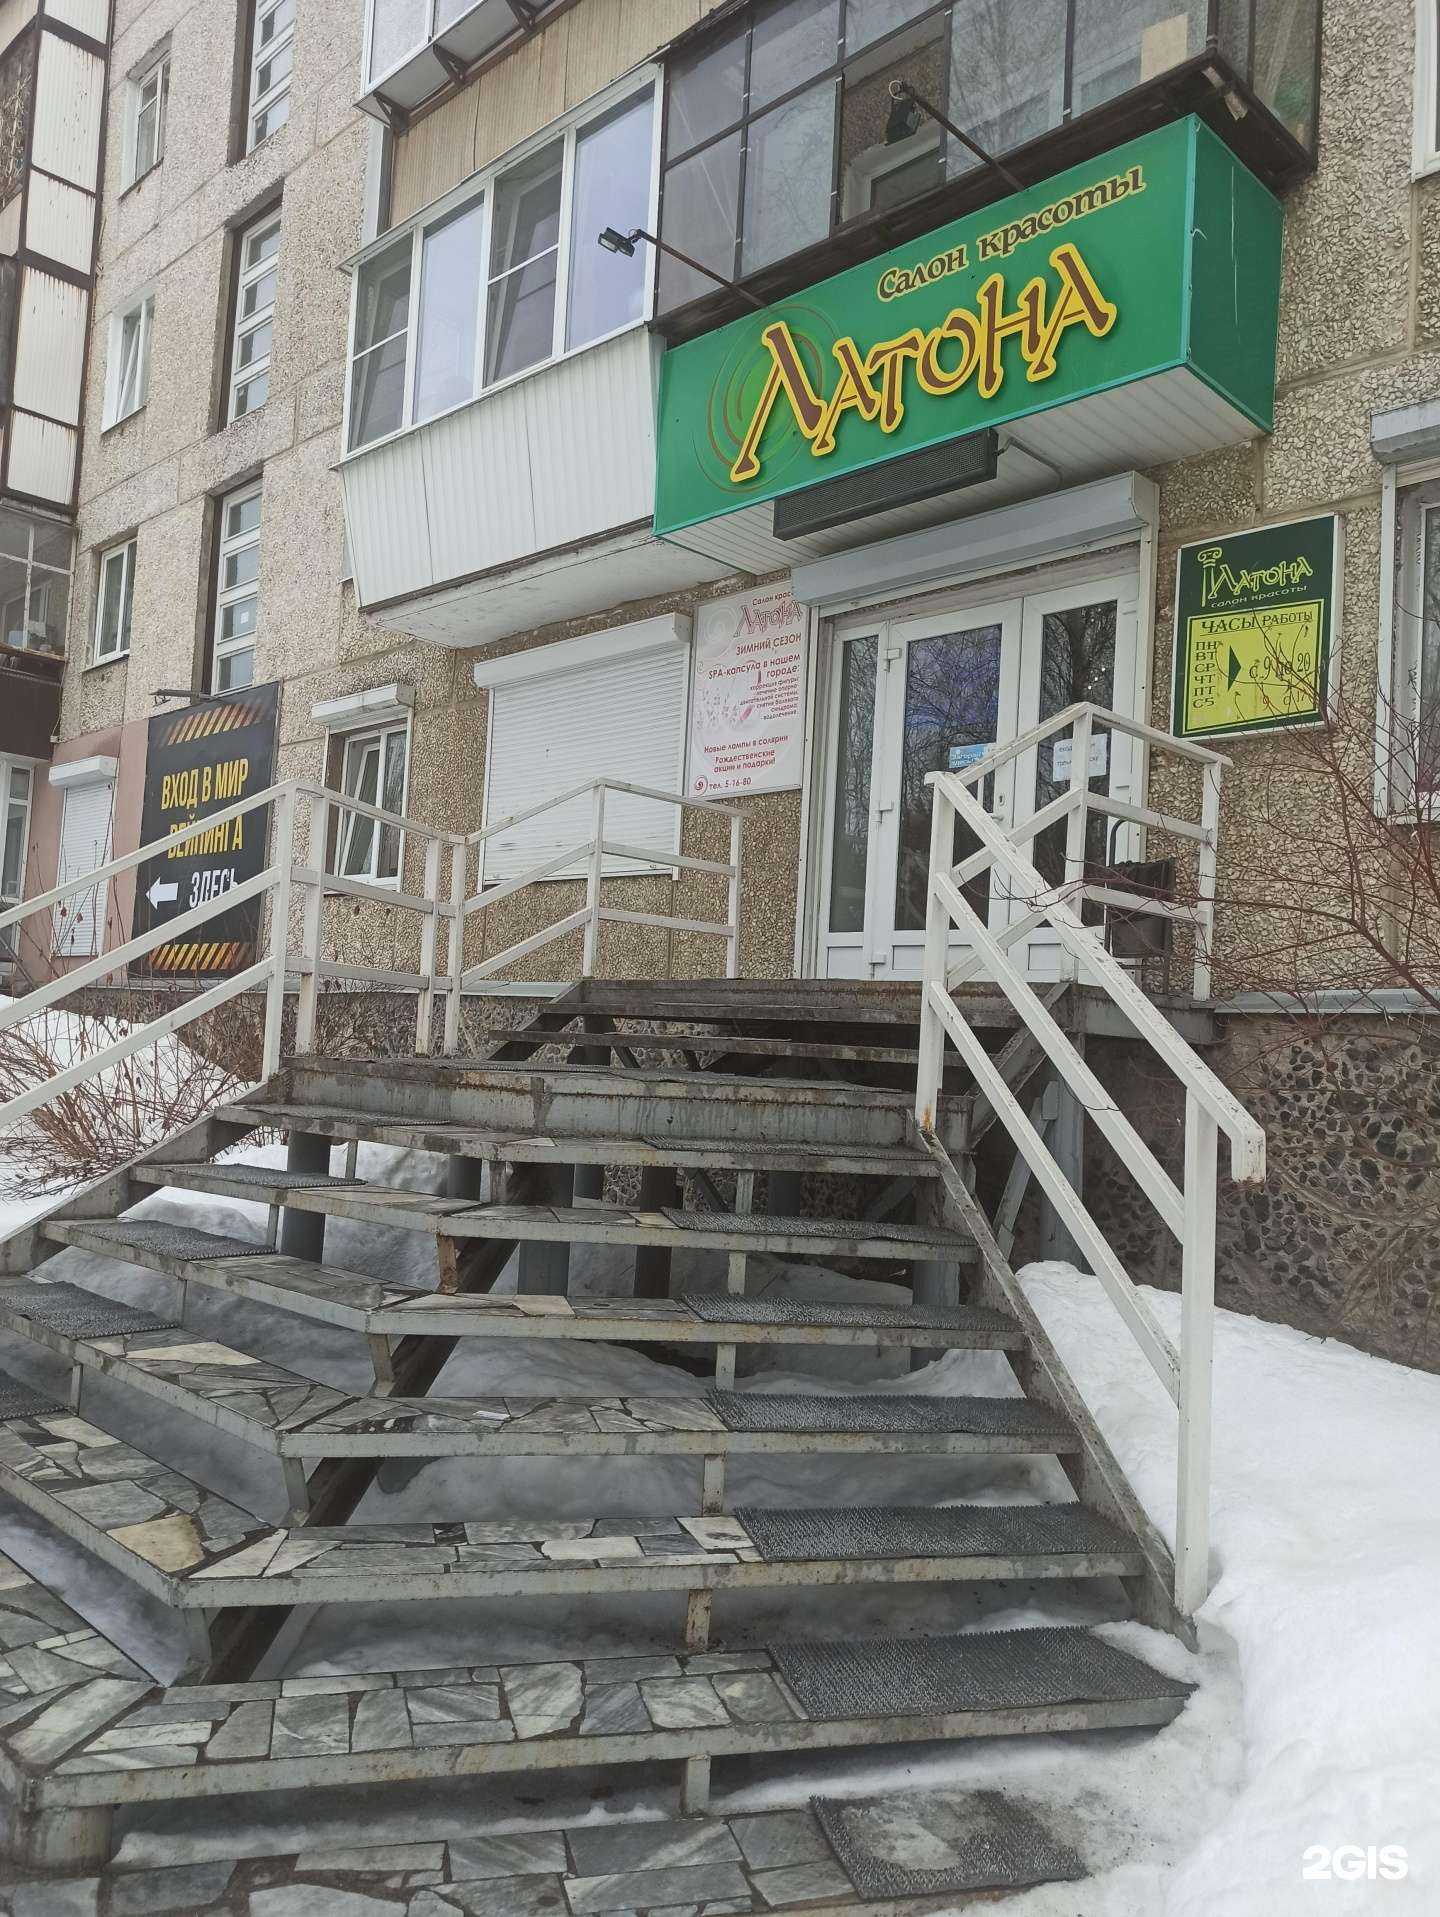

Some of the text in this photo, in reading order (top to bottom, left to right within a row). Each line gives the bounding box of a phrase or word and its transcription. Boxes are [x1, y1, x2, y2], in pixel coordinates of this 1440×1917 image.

[878, 165, 1146, 302] Салон красоты
[775, 592, 794, 601] крас
[1211, 585, 1307, 608] салон красоты
[1202, 611, 1313, 634] ЧАСЫ РАБОТЫ
[736, 633, 802, 656] ЗИМНИЙ СЕЗОН
[1195, 641, 1217, 651] ПН
[770, 654, 801, 666] нашем
[1195, 652, 1216, 661] ВТ
[1297, 652, 1311, 672] 20
[1194, 663, 1215, 673] СР
[1194, 674, 1216, 684] ЧТ
[1194, 686, 1216, 696] ПТ
[704, 742, 726, 753] Новые
[728, 741, 751, 751] лампы
[715, 750, 775, 764] Рождественские
[161, 758, 249, 810] ВХОД В МИР
